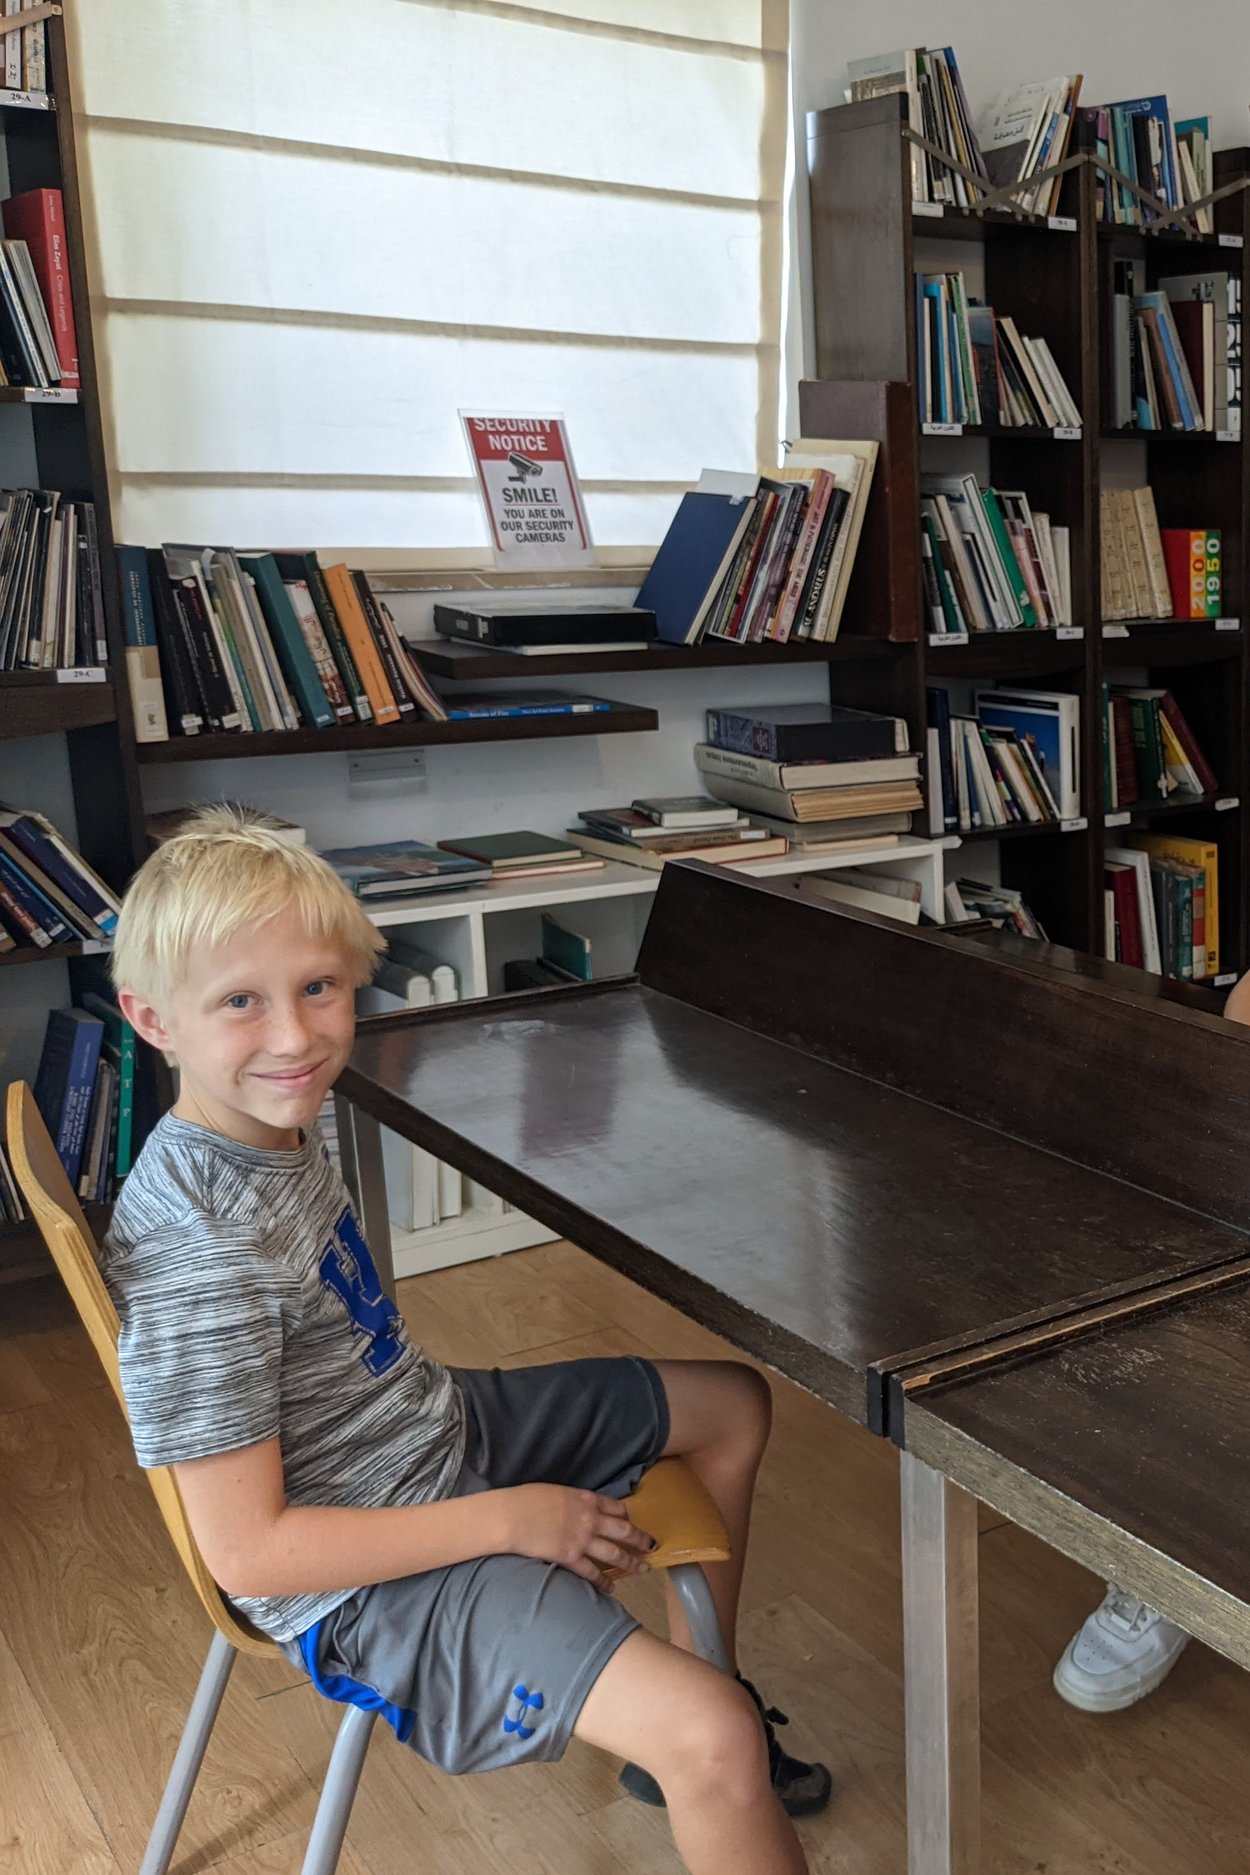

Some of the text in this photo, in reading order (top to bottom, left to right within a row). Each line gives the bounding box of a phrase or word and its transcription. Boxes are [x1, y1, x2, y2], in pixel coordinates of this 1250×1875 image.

[11, 93, 31, 102] 29-A
[474, 418, 552, 433] SECURITY
[488, 434, 548, 451] NOTICE
[502, 488, 559, 503] SMILE!
[504, 509, 565, 519] YOU ARE ON
[501, 520, 574, 531] OUR SECURITY
[516, 532, 566, 543] CAMERAS
[1206, 538, 1220, 605] 1950
[73, 669, 94, 678] 29-C
